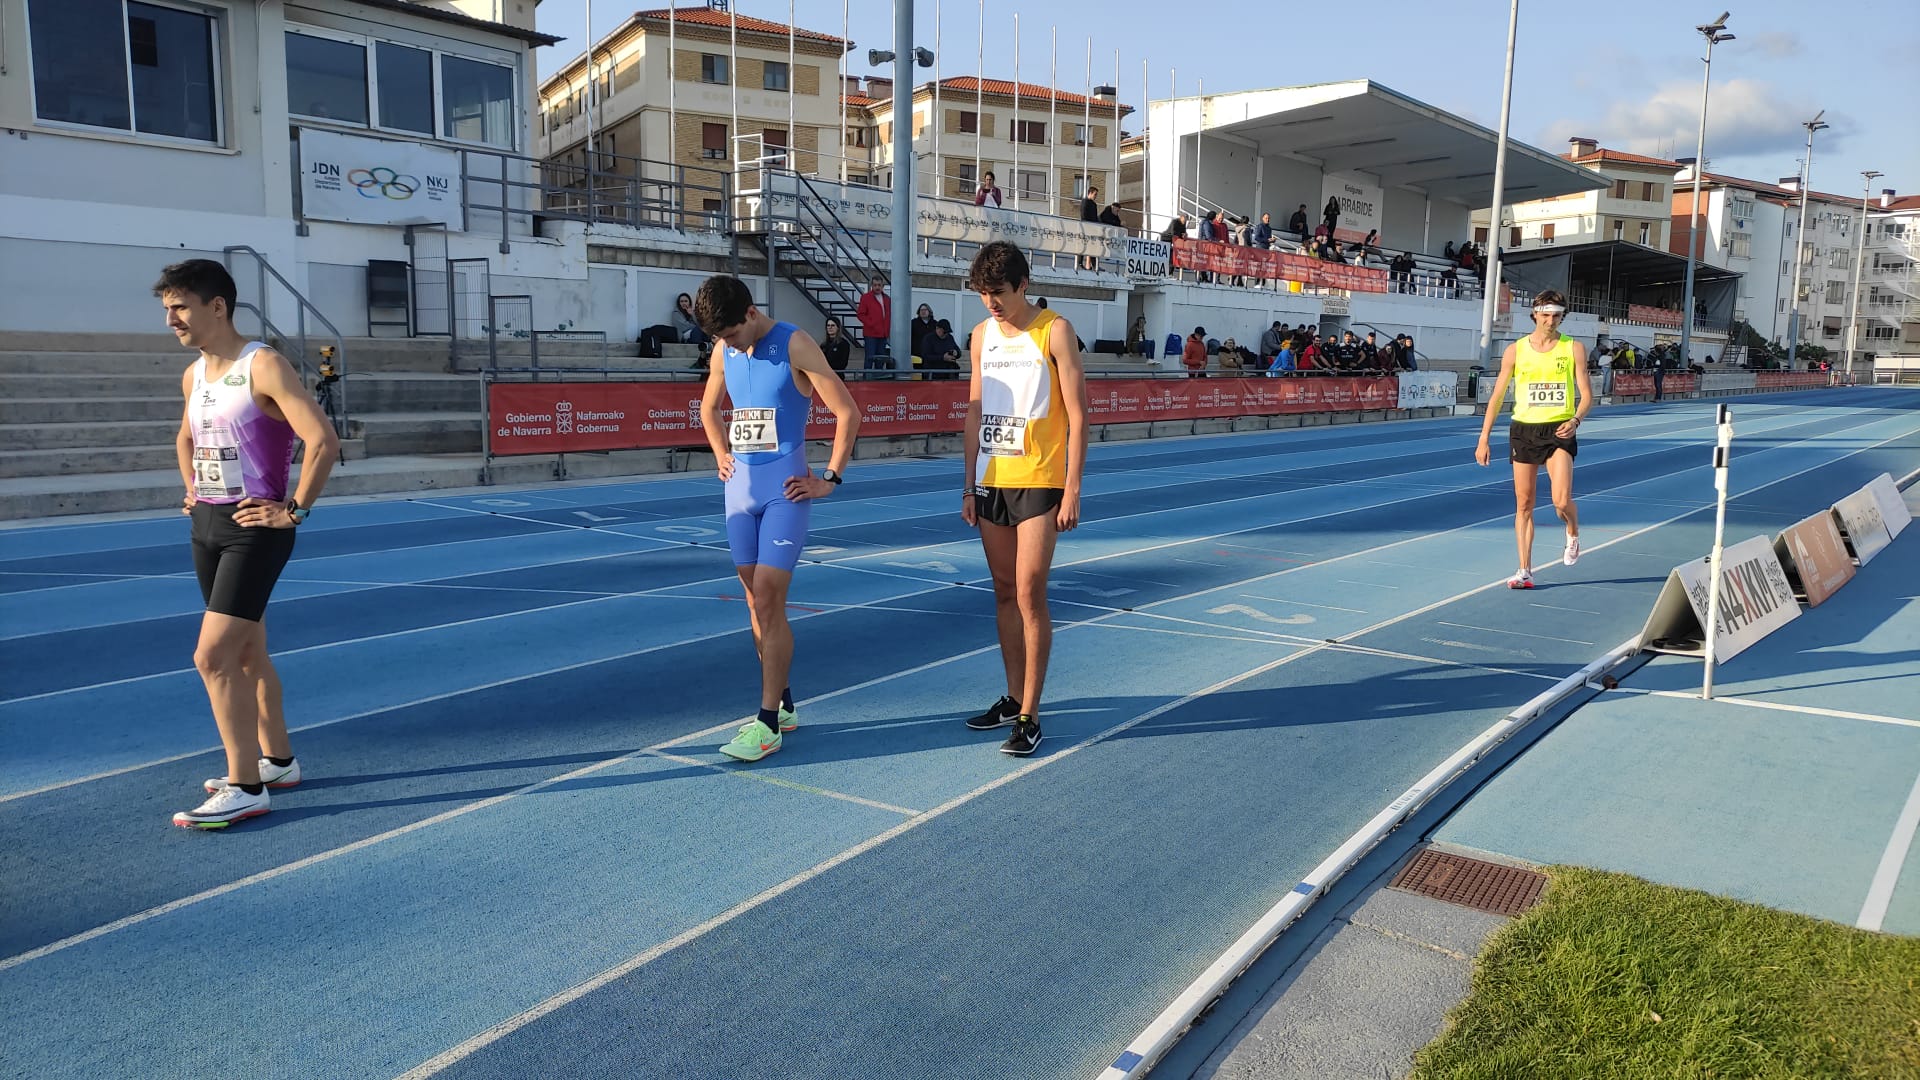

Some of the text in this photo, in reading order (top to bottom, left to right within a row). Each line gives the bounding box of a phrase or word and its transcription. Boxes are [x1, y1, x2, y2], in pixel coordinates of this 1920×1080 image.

[312, 162, 340, 176] JDN
[426, 175, 448, 189] NKJ
[1338, 196, 1373, 217] ARRABIDE
[1128, 240, 1168, 258] IRTEERA
[1128, 259, 1167, 277] SALIDA
[1530, 390, 1565, 401] 1013
[867, 403, 894, 412] Gobierno
[908, 403, 939, 411] Nafarroako
[505, 413, 552, 423] Gobierno
[576, 410, 625, 421] Nafarroako
[648, 409, 687, 419] Gobierno
[862, 415, 870, 423] de
[908, 413, 936, 421] Gobernua
[497, 426, 552, 437] de Navarra
[576, 423, 620, 434] Gobernua
[641, 421, 687, 431] de Navarra
[734, 424, 766, 441] 957
[983, 427, 1016, 445] 664
[197, 462, 220, 482] 15
[1710, 558, 1779, 634] A4XKM
[1204, 603, 1317, 625] 2
